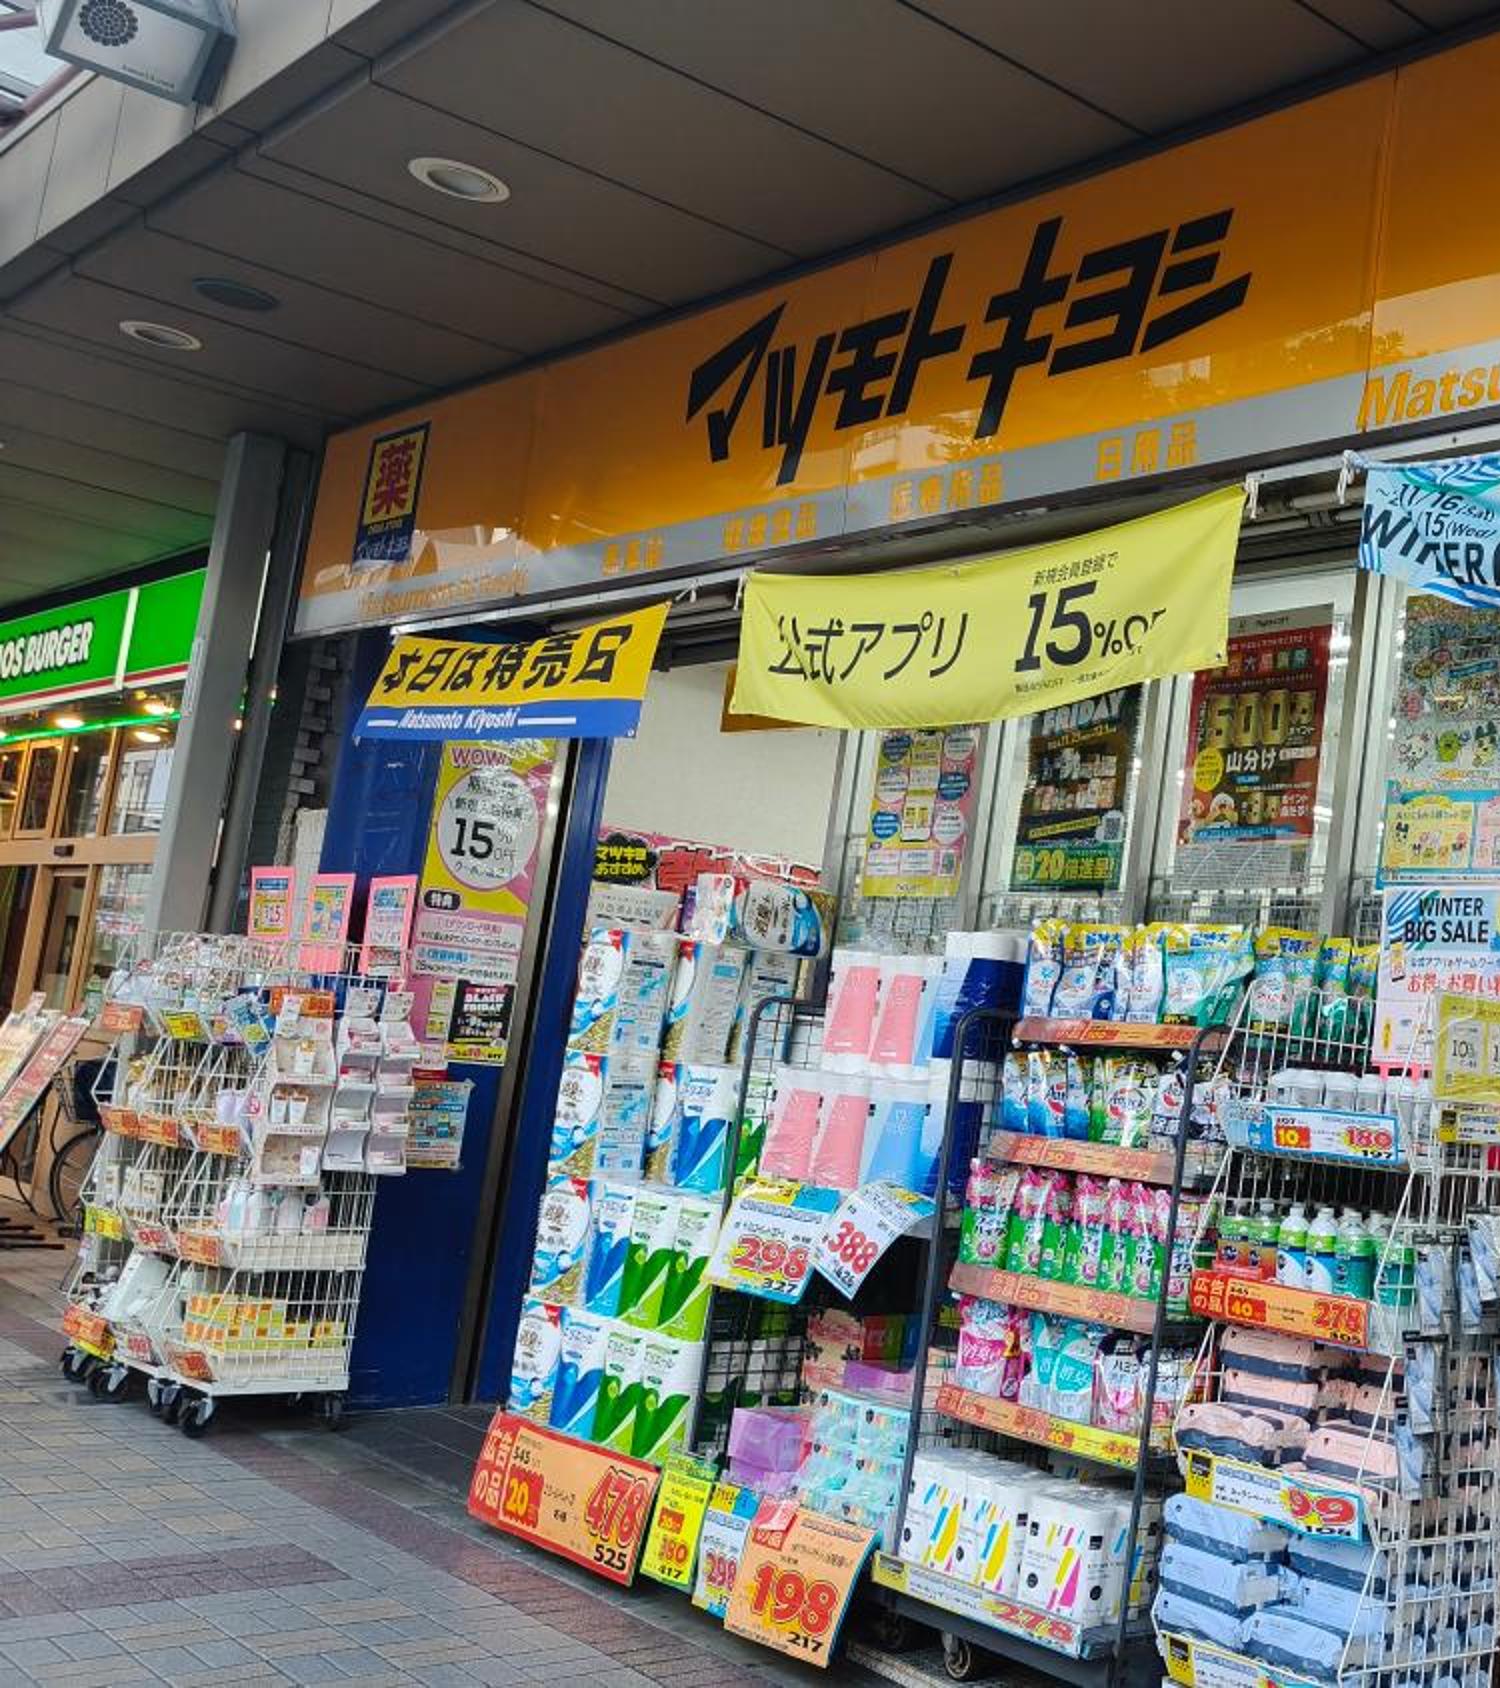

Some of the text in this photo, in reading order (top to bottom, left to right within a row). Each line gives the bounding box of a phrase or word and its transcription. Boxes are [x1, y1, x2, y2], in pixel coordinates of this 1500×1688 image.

[686, 208, 1252, 487] マツモトキヨシ
[371, 438, 416, 516] 薬
[0, 620, 94, 679] OS BURGER
[768, 612, 968, 683] 公式アプリ
[596, 845, 647, 861] マツキヨ
[1419, 897, 1484, 917] WINTER
[1404, 921, 1489, 943] BIG SALE
[1277, 1128, 1299, 1145] 10
[733, 1235, 810, 1282] 298
[828, 1220, 881, 1275] 388
[763, 1278, 798, 1294] 327
[505, 1478, 530, 1517] 20
[584, 1465, 649, 1548] 478
[594, 1543, 628, 1571] 525
[751, 1560, 839, 1636] 198
[786, 1631, 824, 1653] 217
